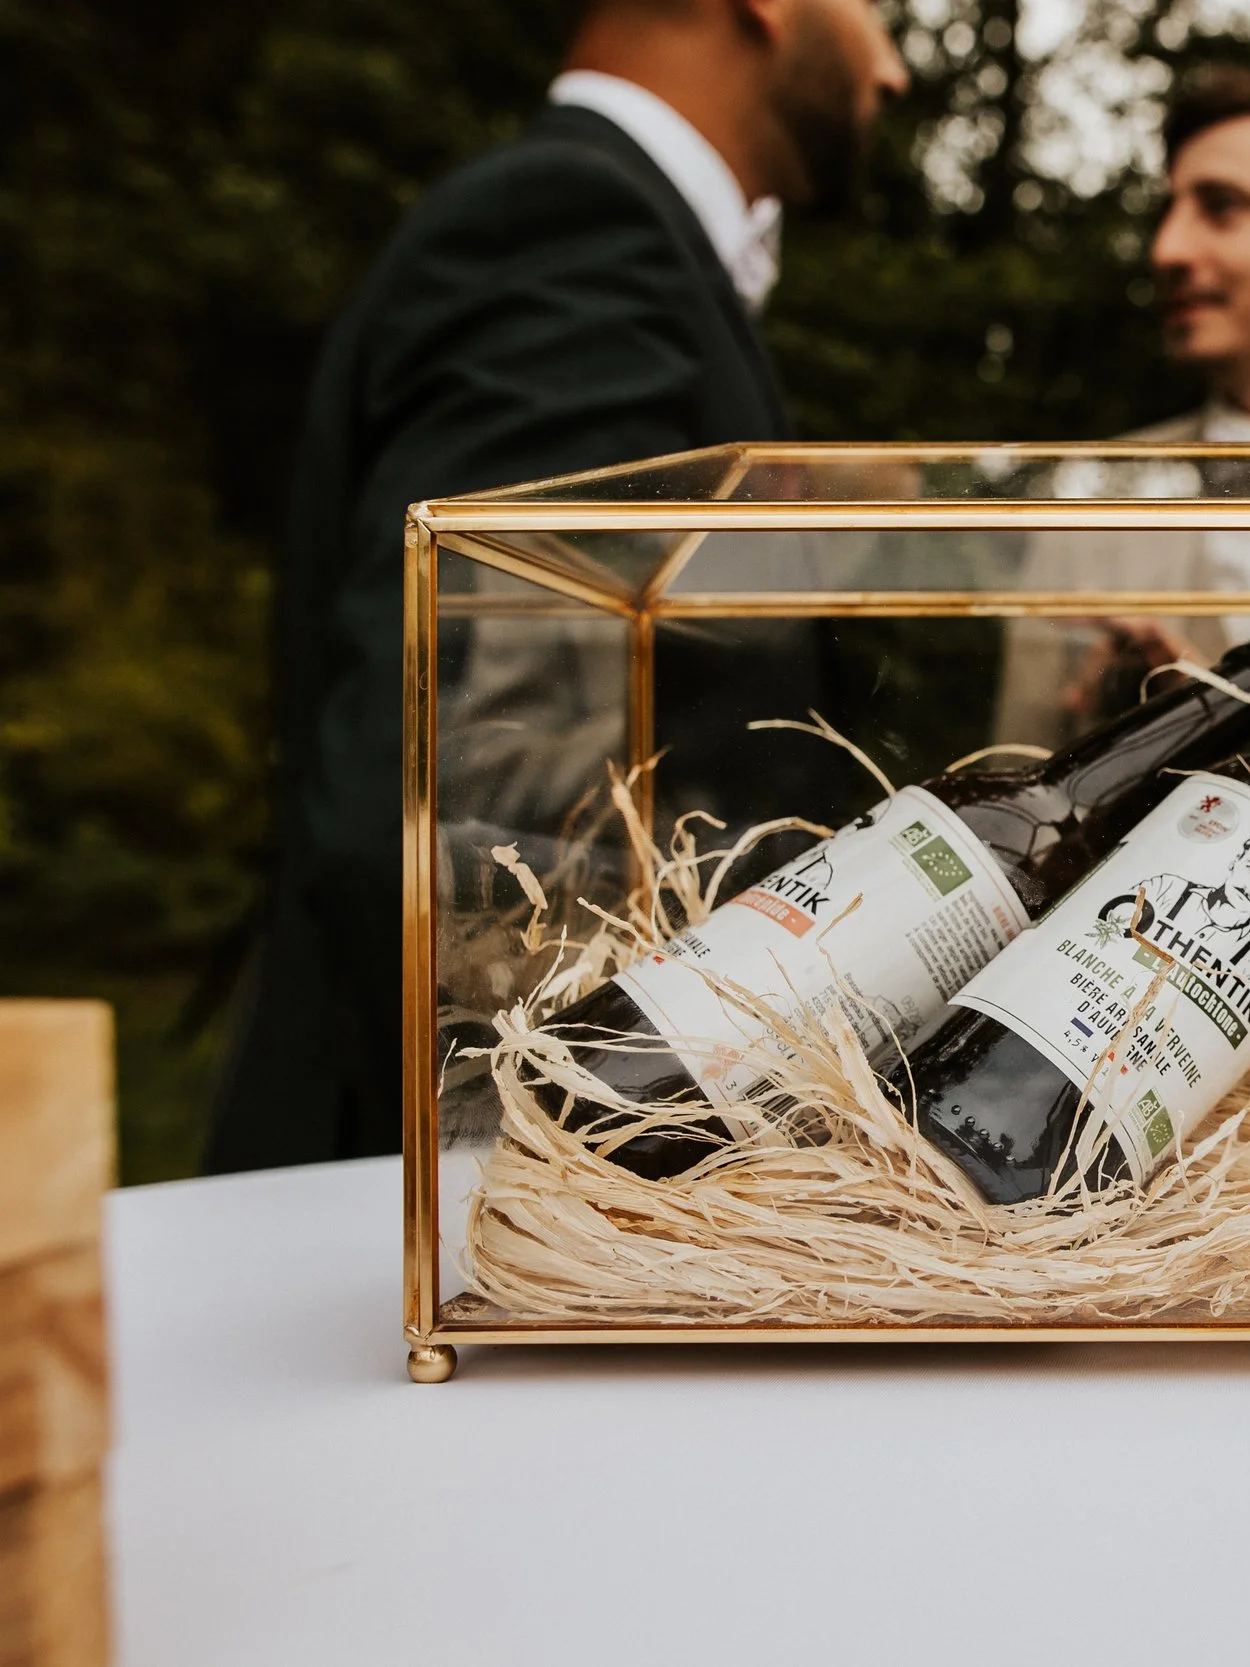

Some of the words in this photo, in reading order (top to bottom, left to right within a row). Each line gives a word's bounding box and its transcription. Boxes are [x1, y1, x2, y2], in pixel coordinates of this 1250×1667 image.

[759, 874, 831, 915] ENTIK
[1056, 939, 1125, 989] BLANCHE
[1123, 983, 1137, 1000] À
[1154, 1017, 1202, 1088] VRVEINE
[1070, 972, 1109, 1005] BIÈRE
[1105, 1002, 1171, 1076] ARSANLE
[1152, 957, 1239, 1041] LAutochtone
[1063, 1030, 1089, 1053] 4,5%
[1077, 1000, 1148, 1072] D'AUVEGNE
[1138, 1099, 1154, 1117] AB
